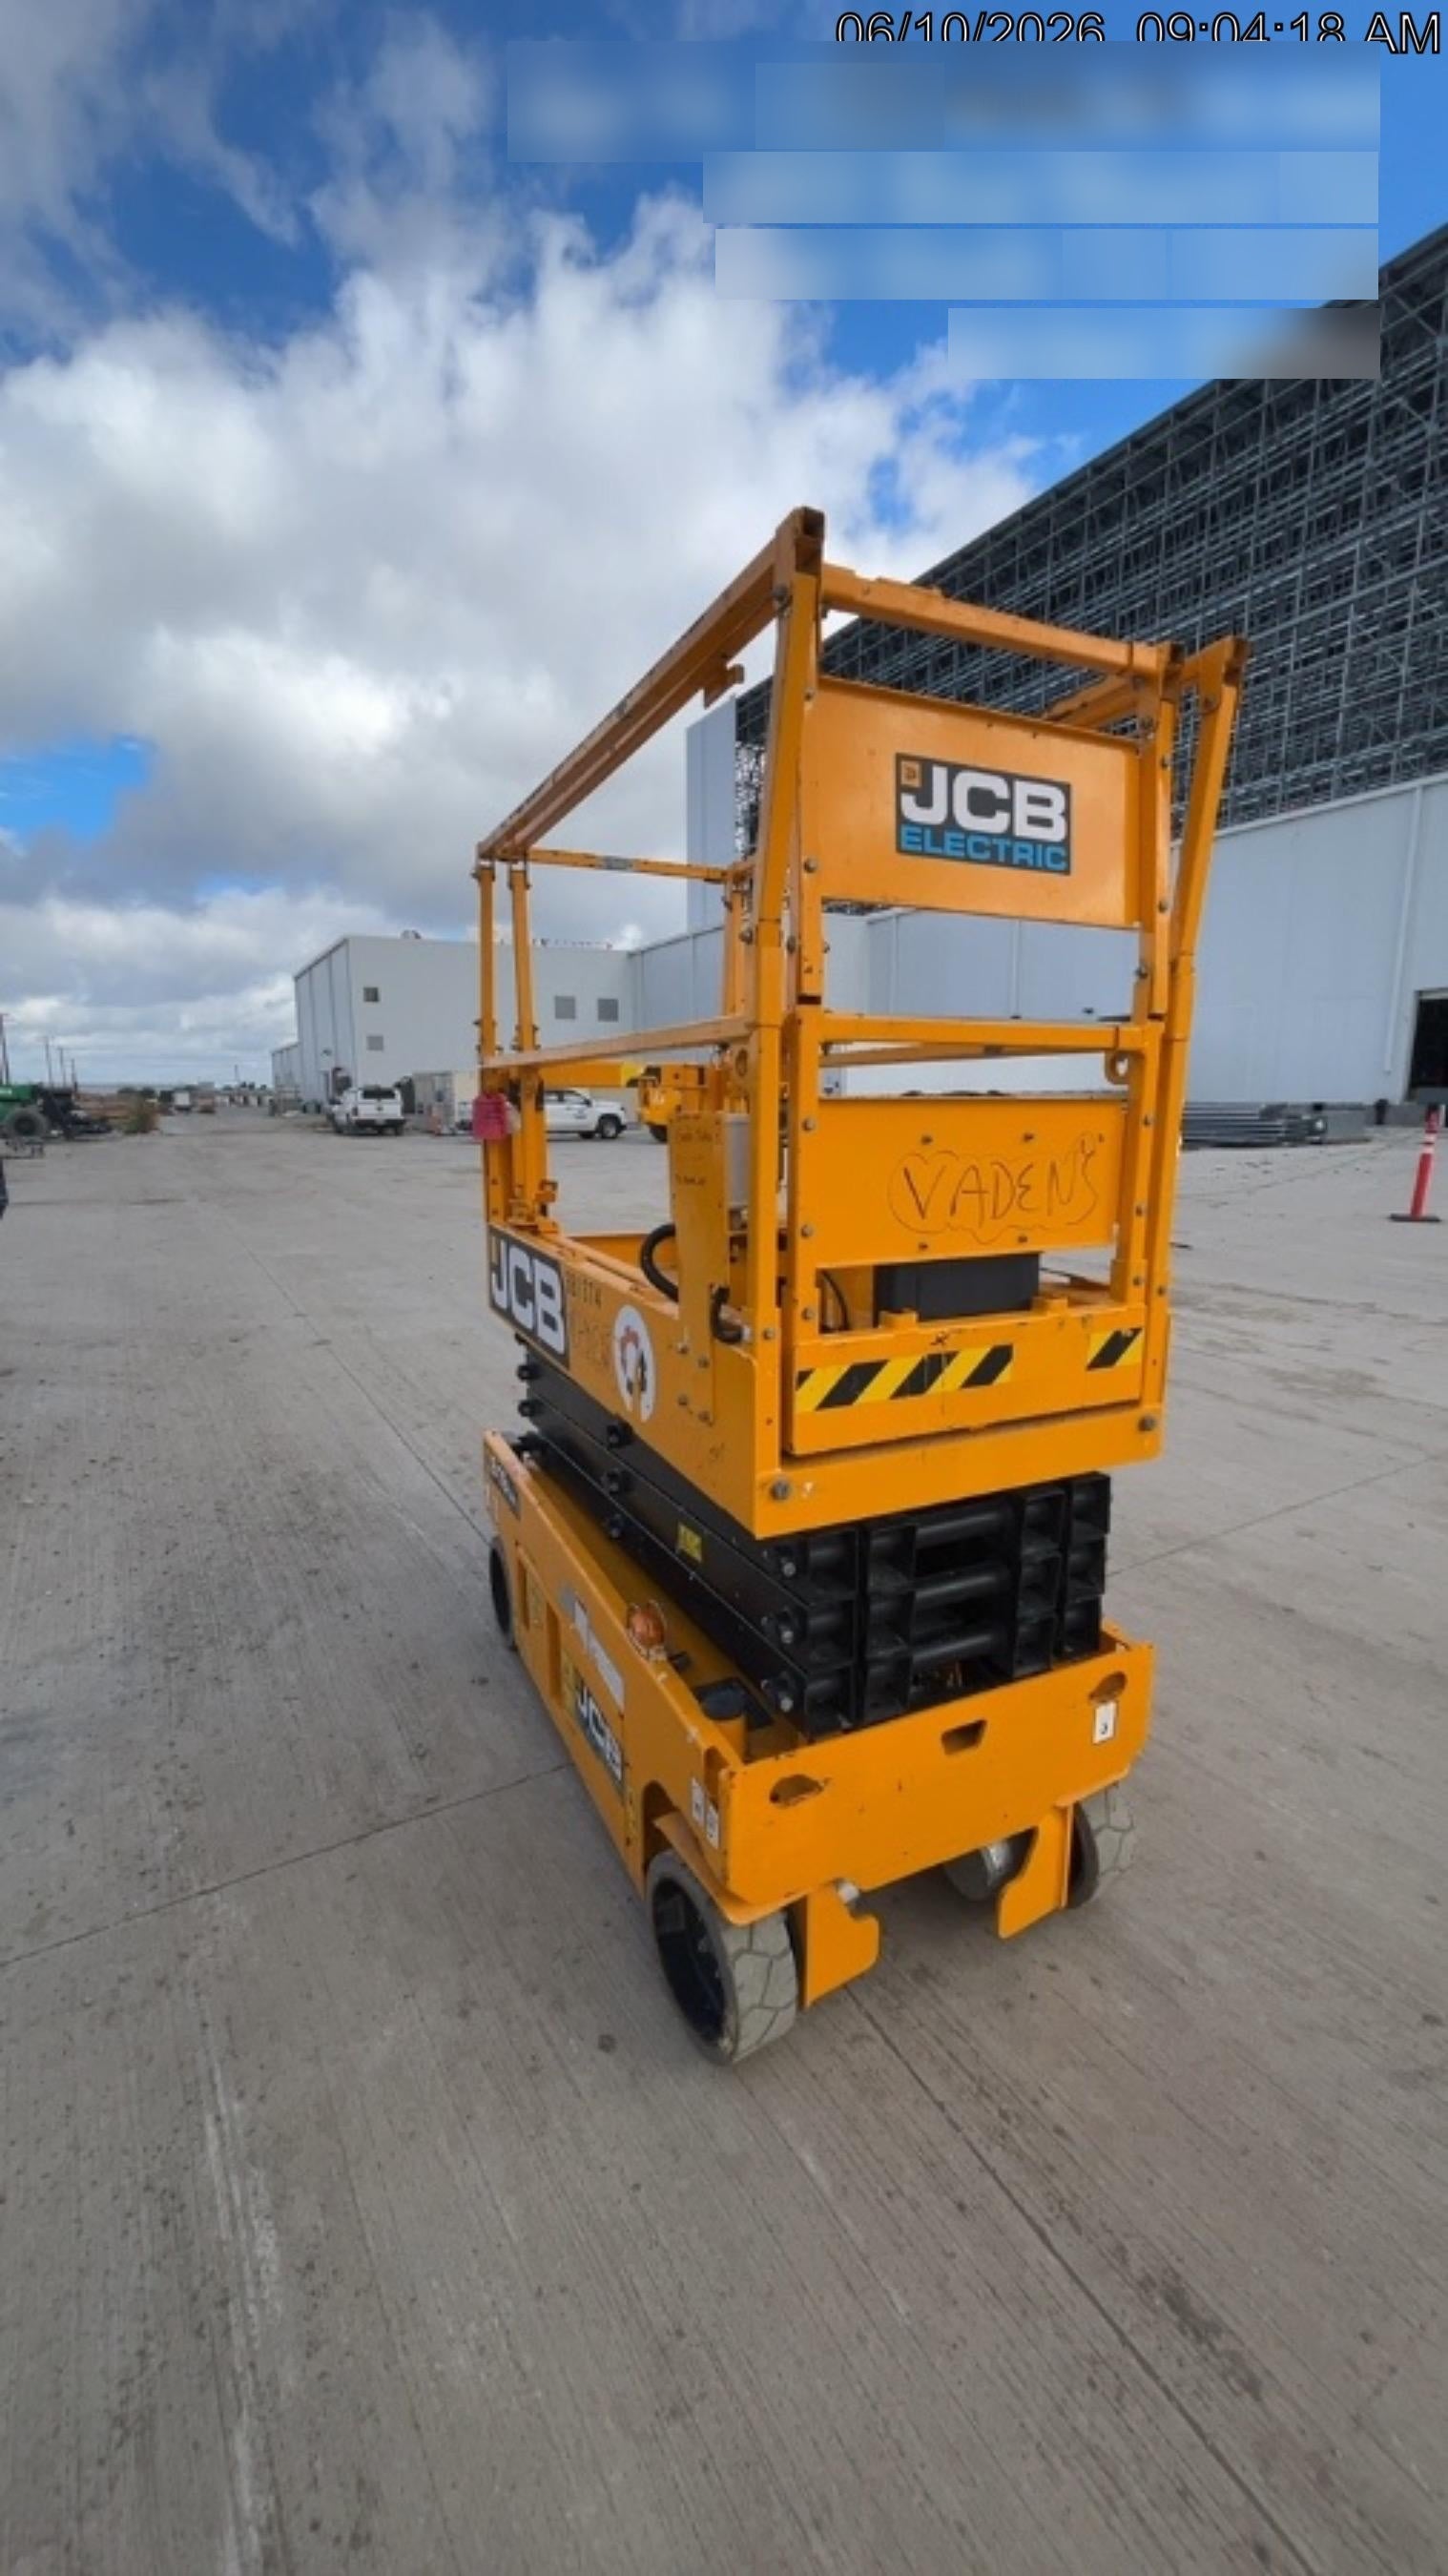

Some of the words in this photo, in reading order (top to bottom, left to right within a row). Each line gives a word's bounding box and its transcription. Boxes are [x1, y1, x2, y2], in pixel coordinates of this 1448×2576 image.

[900, 765, 1065, 842] JCB
[900, 823, 1066, 870] ELECTRIC
[491, 1237, 566, 1354] JCB
